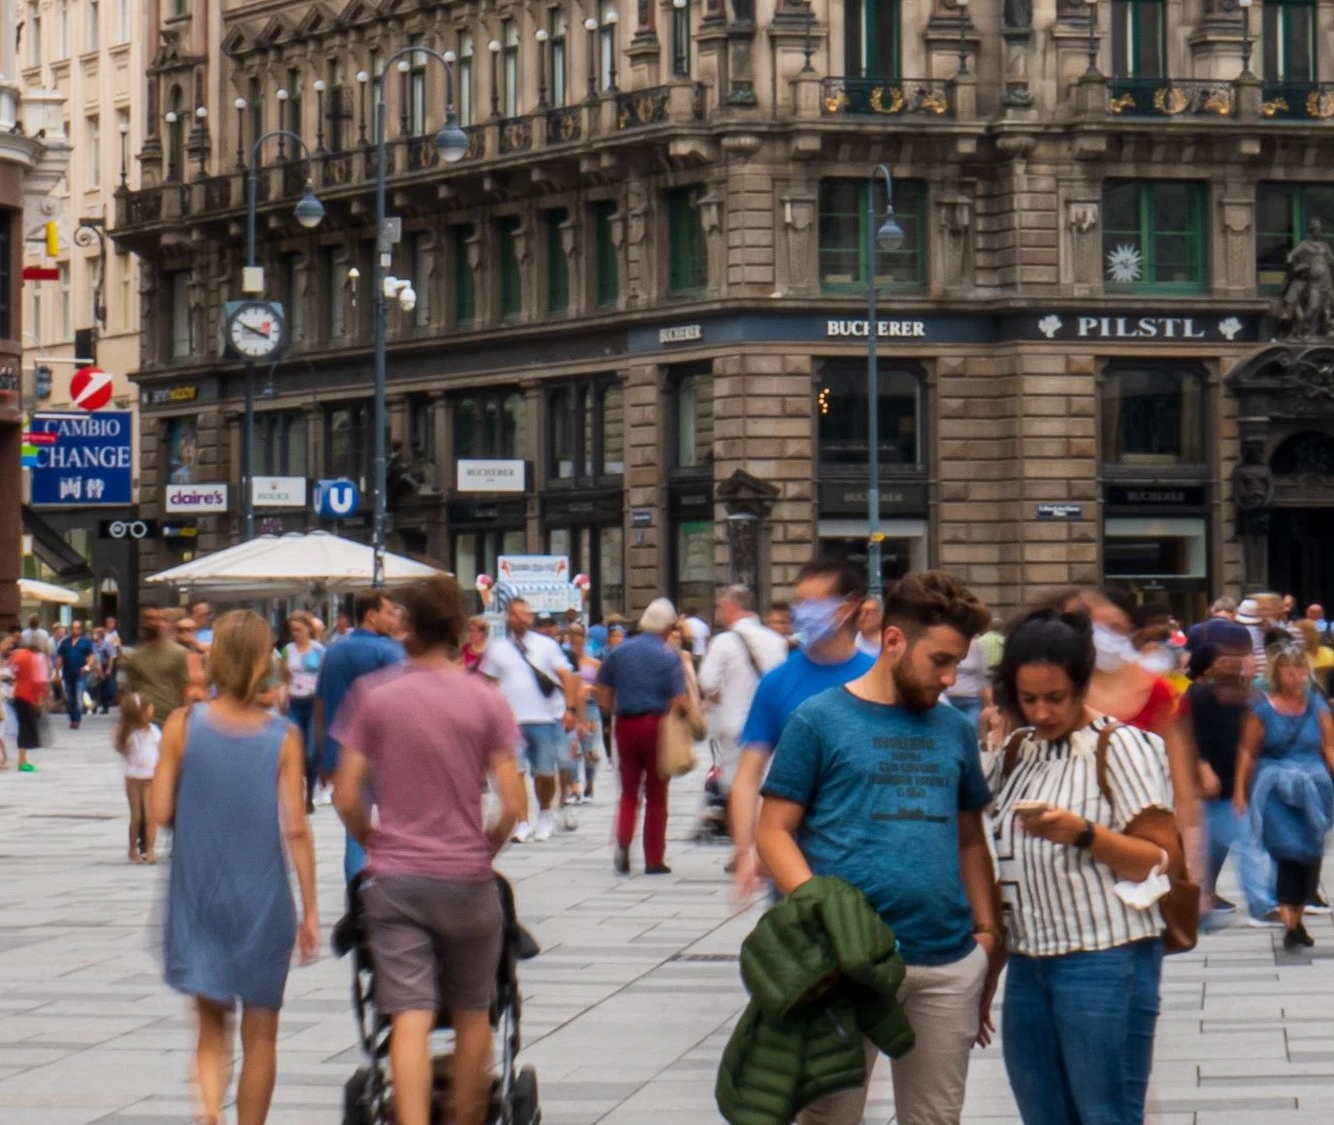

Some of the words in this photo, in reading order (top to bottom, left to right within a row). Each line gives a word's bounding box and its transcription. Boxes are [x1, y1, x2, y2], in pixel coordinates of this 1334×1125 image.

[1076, 317, 1205, 338] PILSTL
[44, 418, 121, 436] CAMBIO
[35, 446, 131, 468] CHANGE
[170, 489, 223, 505] claire's
[330, 487, 353, 513] U
